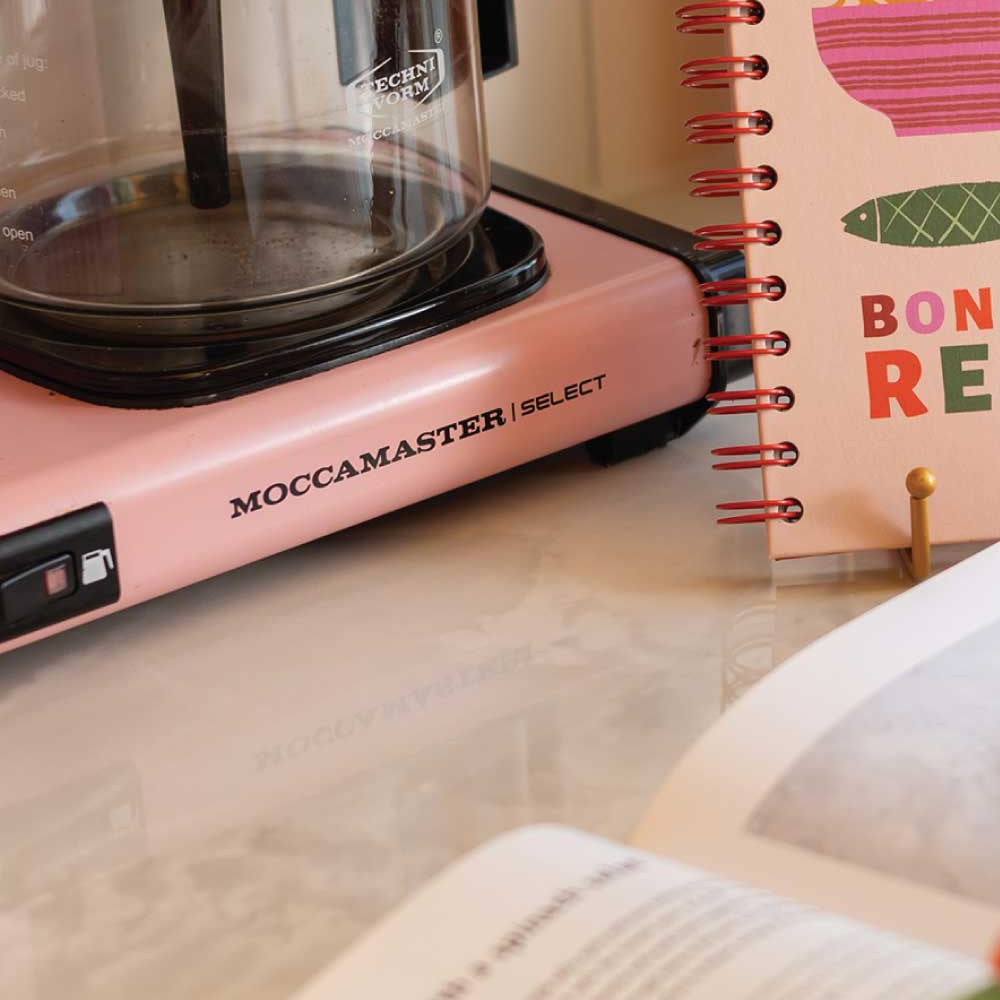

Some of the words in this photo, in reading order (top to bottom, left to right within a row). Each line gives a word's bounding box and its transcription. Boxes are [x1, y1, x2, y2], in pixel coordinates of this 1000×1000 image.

[360, 56, 436, 98] TECHNI
[2, 226, 34, 242] open
[860, 287, 994, 338] BON
[230, 406, 507, 519] MOCCAMASTER
[521, 374, 607, 417] SELECT
